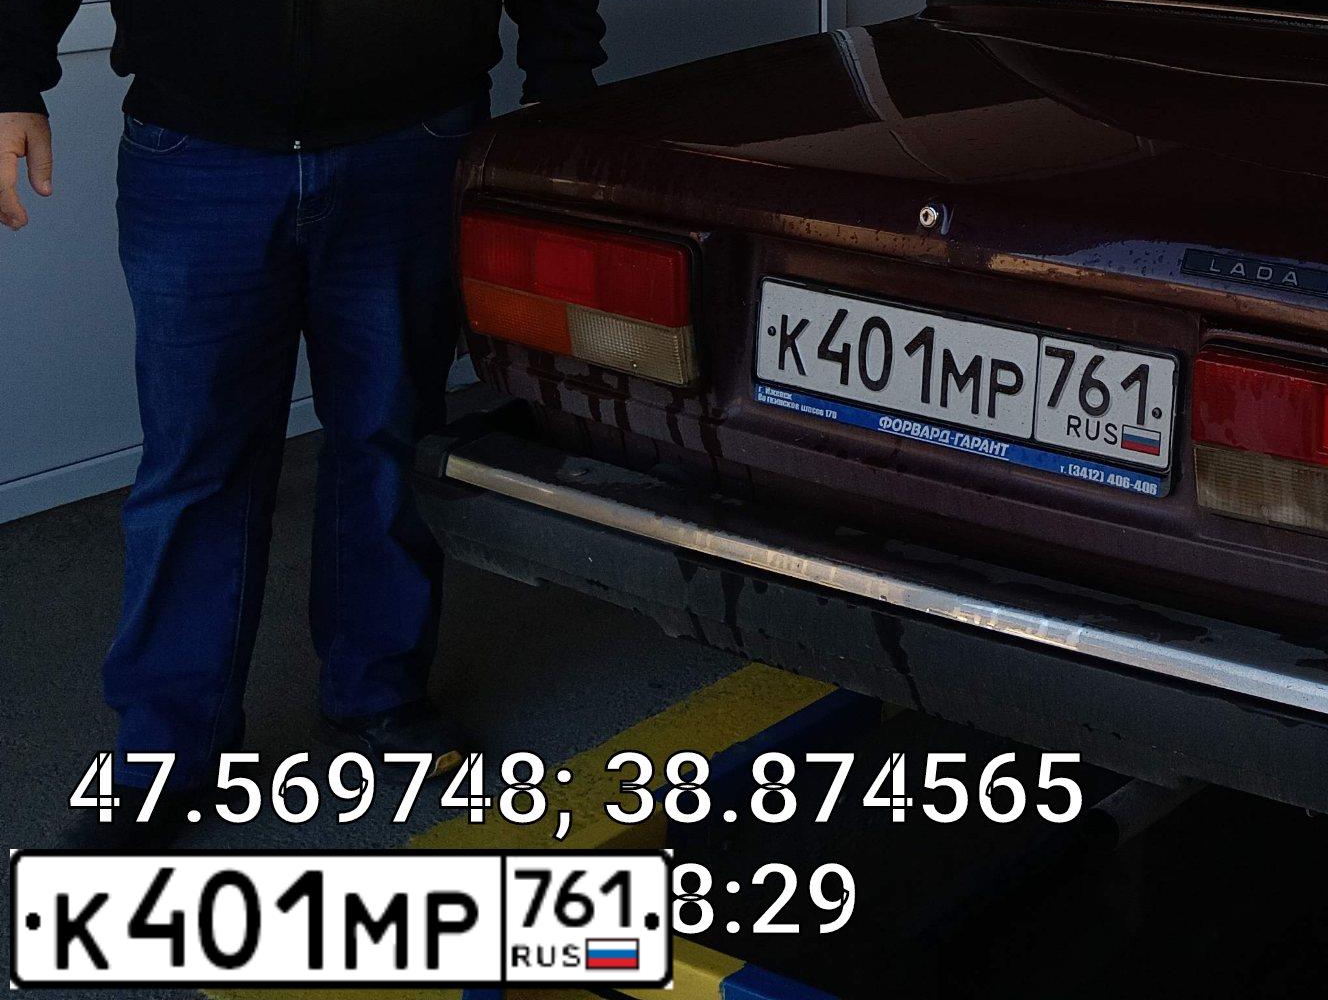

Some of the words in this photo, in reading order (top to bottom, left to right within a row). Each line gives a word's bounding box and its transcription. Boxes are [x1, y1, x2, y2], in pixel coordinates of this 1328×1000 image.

[1209, 258, 1299, 286] LADA
[778, 308, 1024, 419] К401МР
[1045, 346, 1150, 426] 761
[878, 416, 1010, 457] ФОРВАРД-ГАРАНТ
[1066, 414, 1118, 446] RUS
[1068, 463, 1105, 483] (3412)
